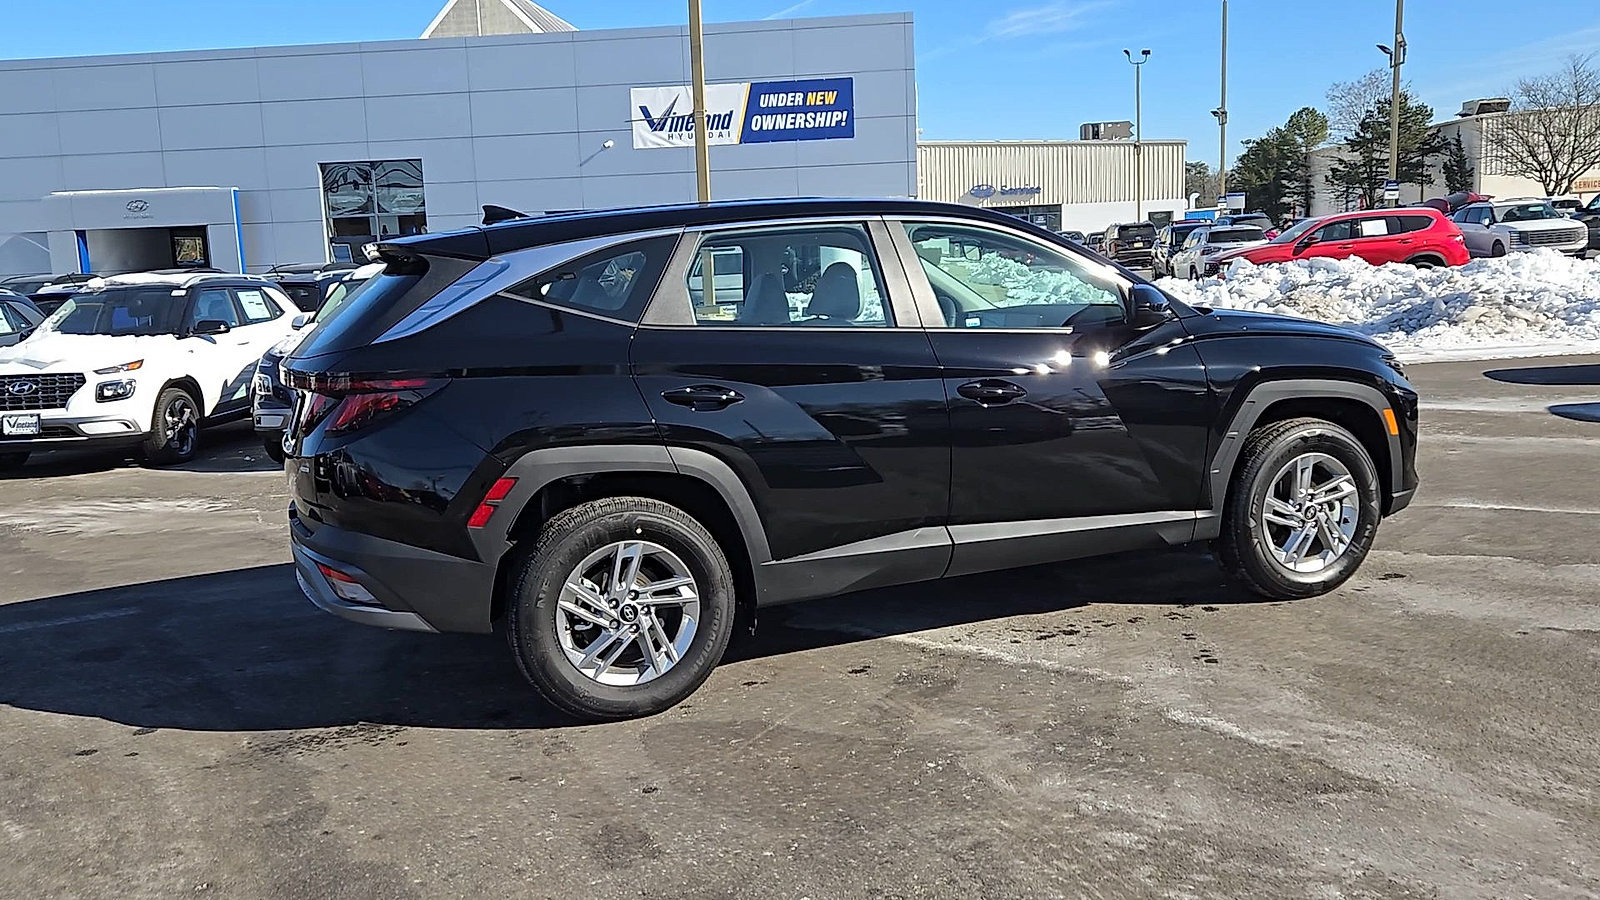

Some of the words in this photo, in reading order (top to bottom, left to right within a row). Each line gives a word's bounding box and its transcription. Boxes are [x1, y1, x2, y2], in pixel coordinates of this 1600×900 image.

[760, 92, 804, 108] UNDER
[806, 90, 837, 106] NEW
[639, 93, 734, 132] Vinend
[751, 110, 848, 131] OWNERSHIP!
[667, 131, 731, 140] HYUDAI
